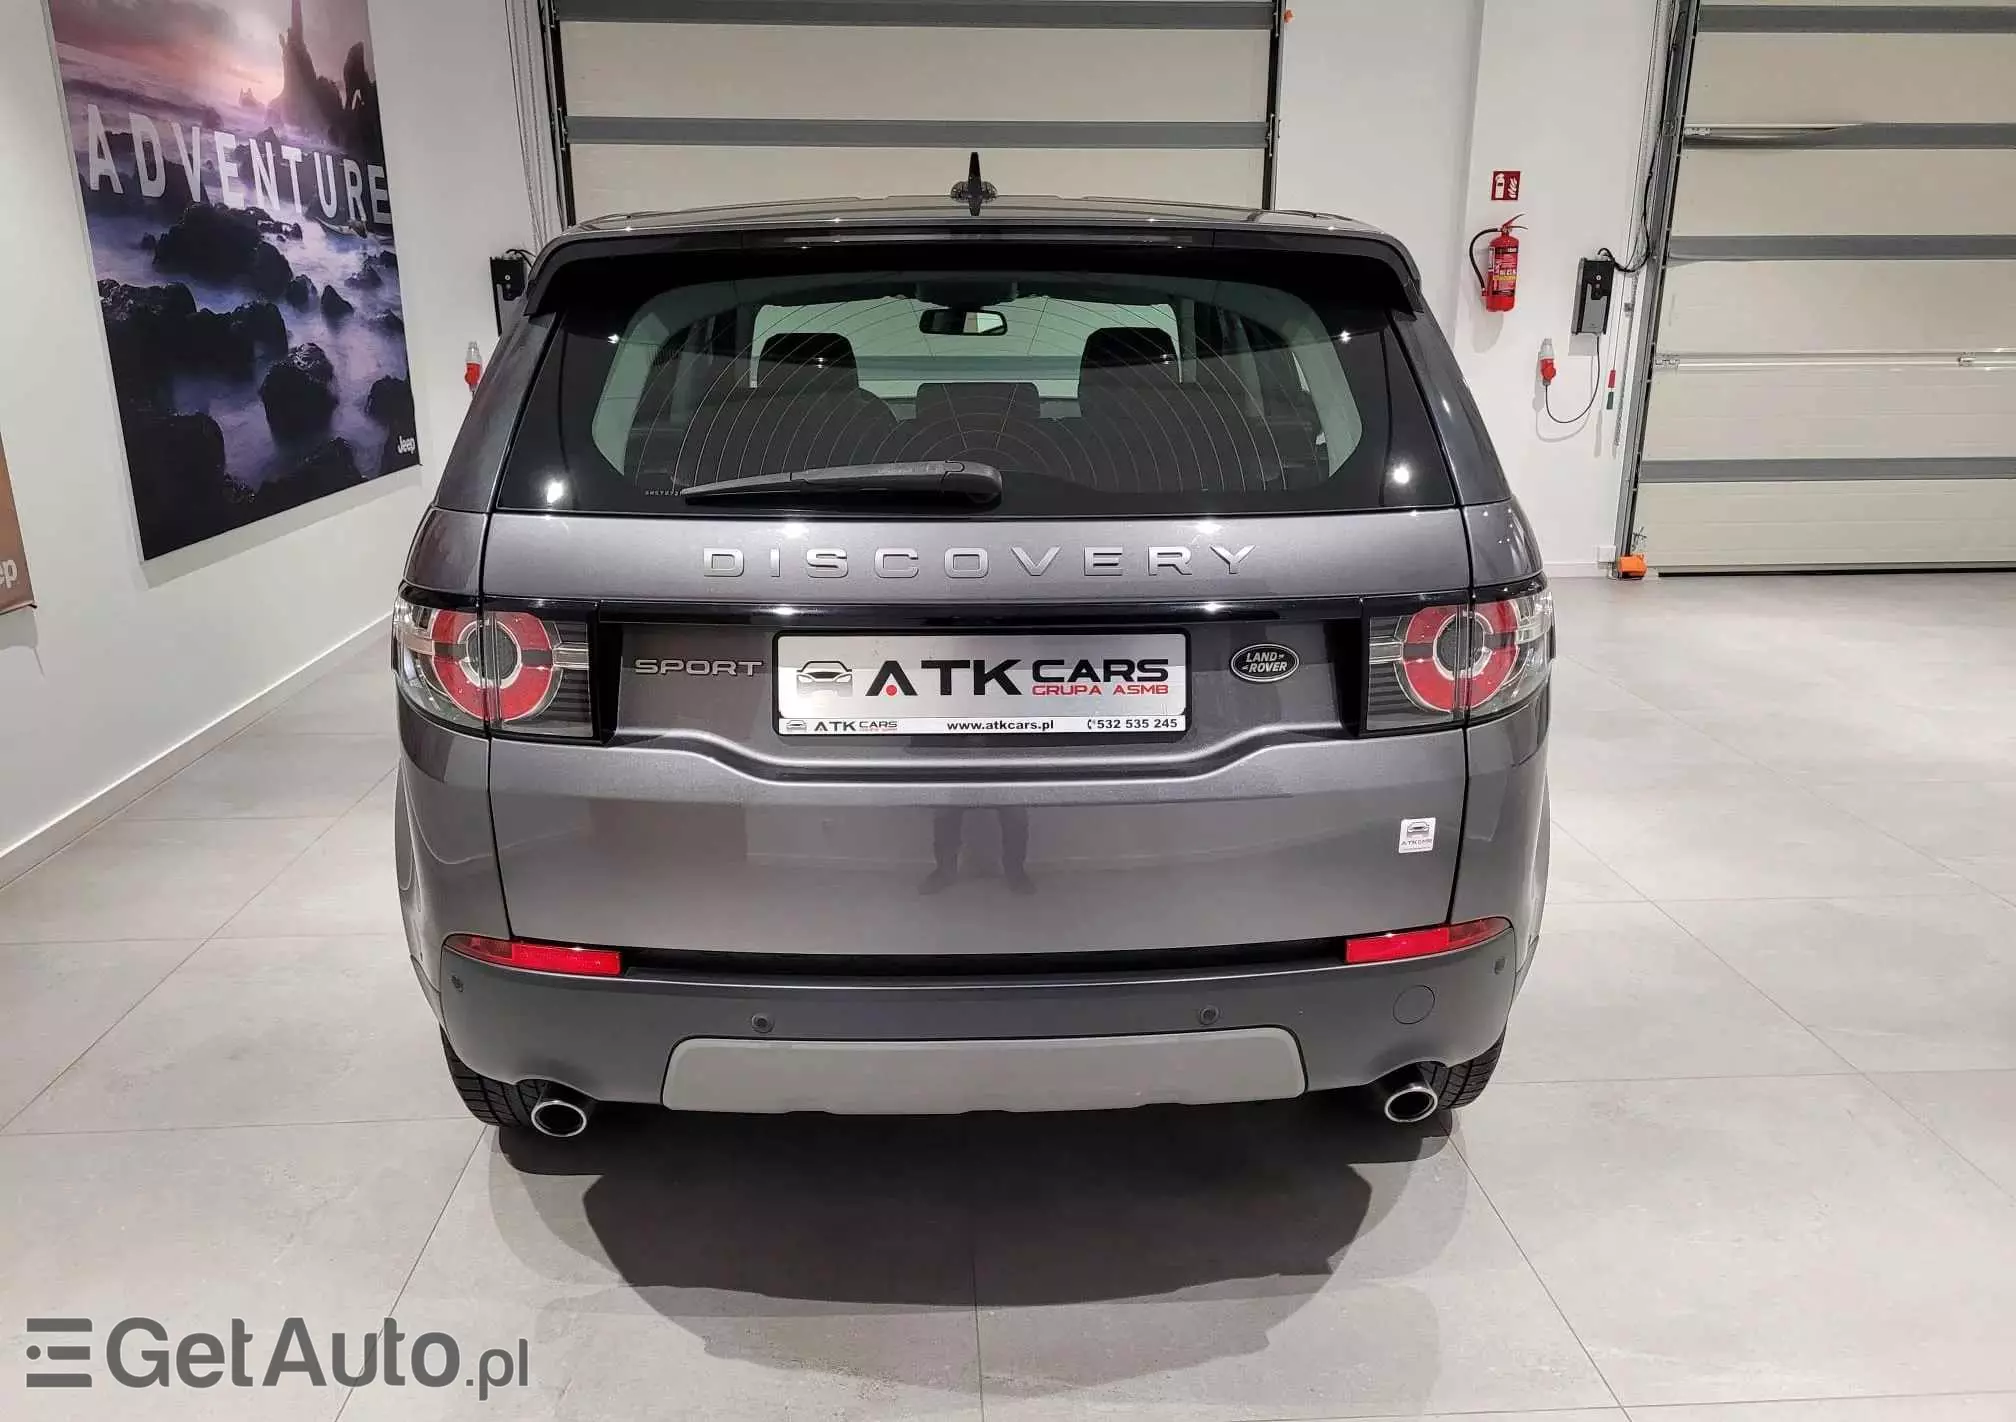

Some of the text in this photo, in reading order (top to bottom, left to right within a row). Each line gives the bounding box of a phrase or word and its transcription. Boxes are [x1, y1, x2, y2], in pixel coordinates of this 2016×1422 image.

[87, 103, 392, 224] ADVENTURE
[397, 435, 416, 455] Jeep
[703, 544, 1256, 579] DISCOVERY
[1245, 652, 1278, 662] LAND
[635, 659, 763, 676] SPORT
[1248, 662, 1288, 673] ROVER
[865, 659, 1169, 697] ATK CARS
[1032, 684, 1169, 696] GRUPA ASMB
[814, 721, 856, 731] ATK
[946, 719, 1054, 732] www.atkcars.pl
[1097, 718, 1178, 729] 532 535 245
